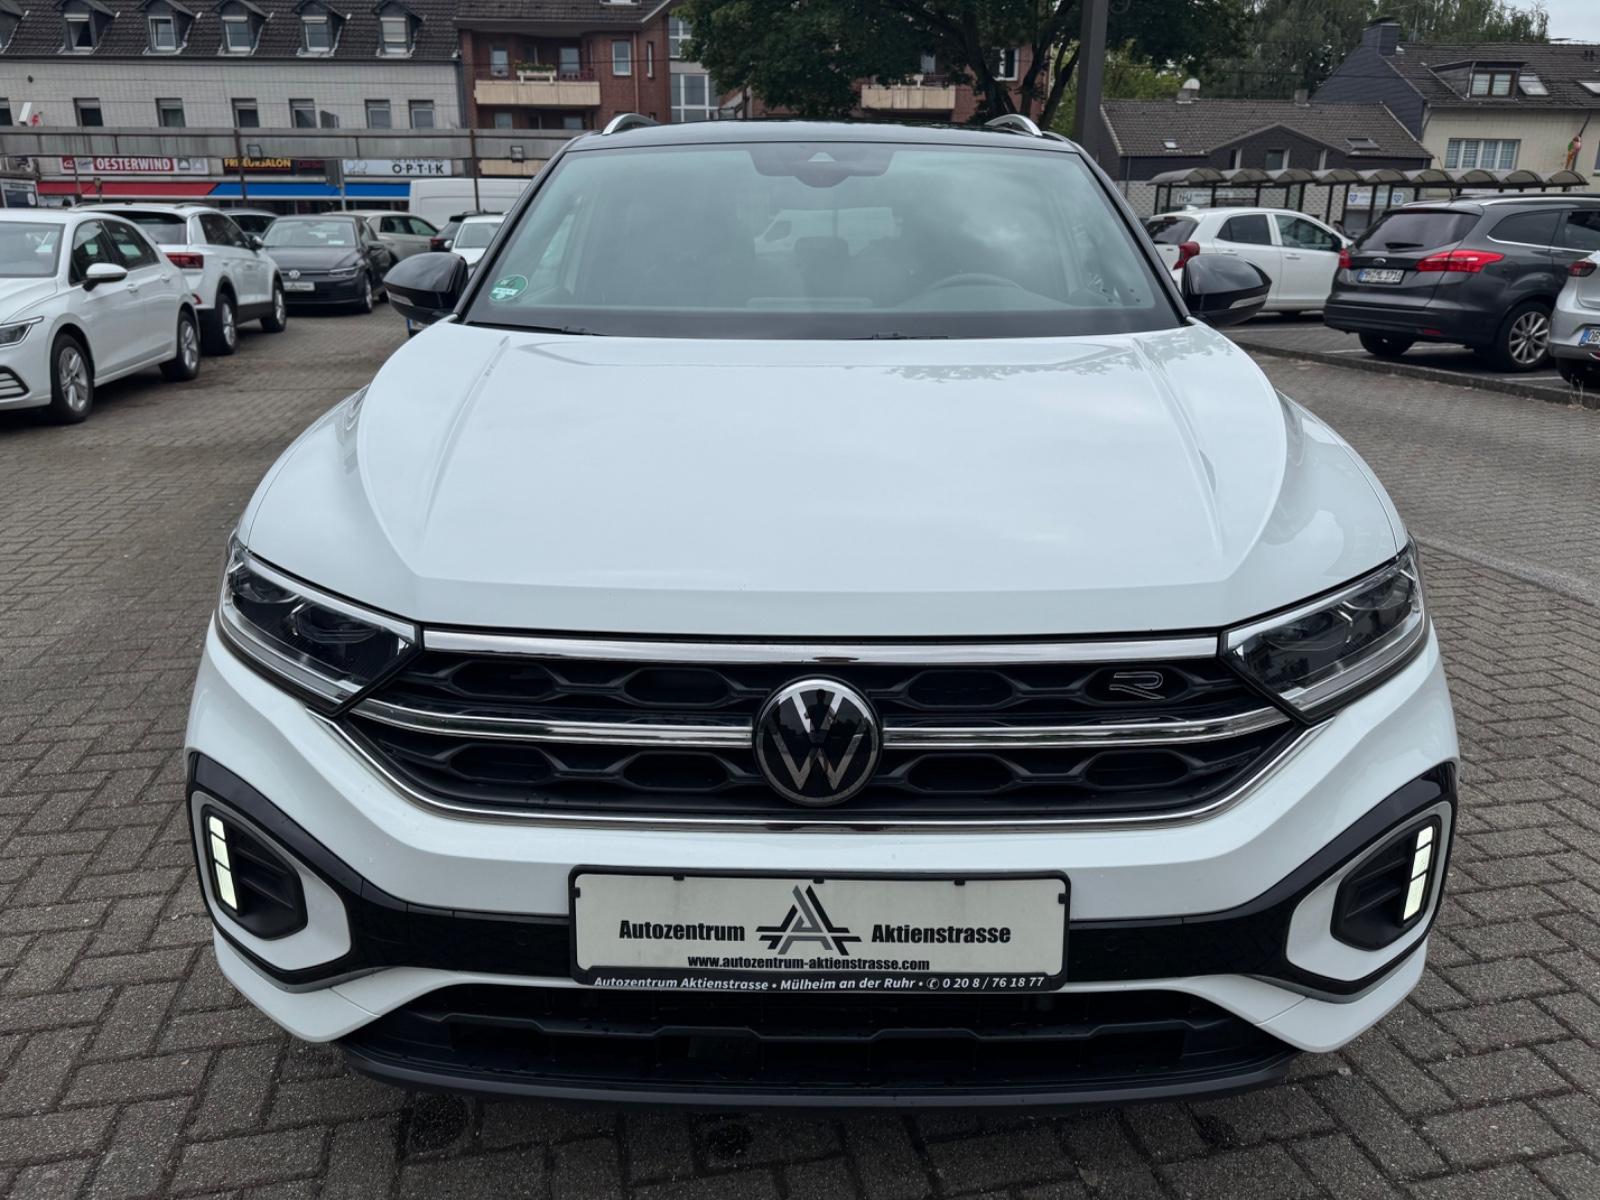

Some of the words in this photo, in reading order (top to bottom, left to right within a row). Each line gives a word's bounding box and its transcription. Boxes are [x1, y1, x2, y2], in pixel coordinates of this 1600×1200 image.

[96, 158, 171, 171] OESTERWIND
[224, 158, 292, 168] FRIEURSALON
[619, 919, 746, 942] Autozentrum
[871, 924, 1012, 944] Aktienstrasse
[687, 955, 931, 971] www.autozentrum-aktienstrasse.com
[593, 976, 678, 988] Autozentrum
[680, 977, 769, 991] Aktienstrasse
[780, 978, 837, 990] Mülheim
[838, 979, 856, 989] an
[858, 977, 881, 989] der
[883, 978, 916, 989] Ruhr
[942, 978, 951, 988] 0
[953, 978, 970, 988] 20
[972, 978, 981, 988] 8
[992, 977, 1008, 988] 76
[1009, 977, 1026, 988] 18
[1029, 976, 1045, 988] 77
